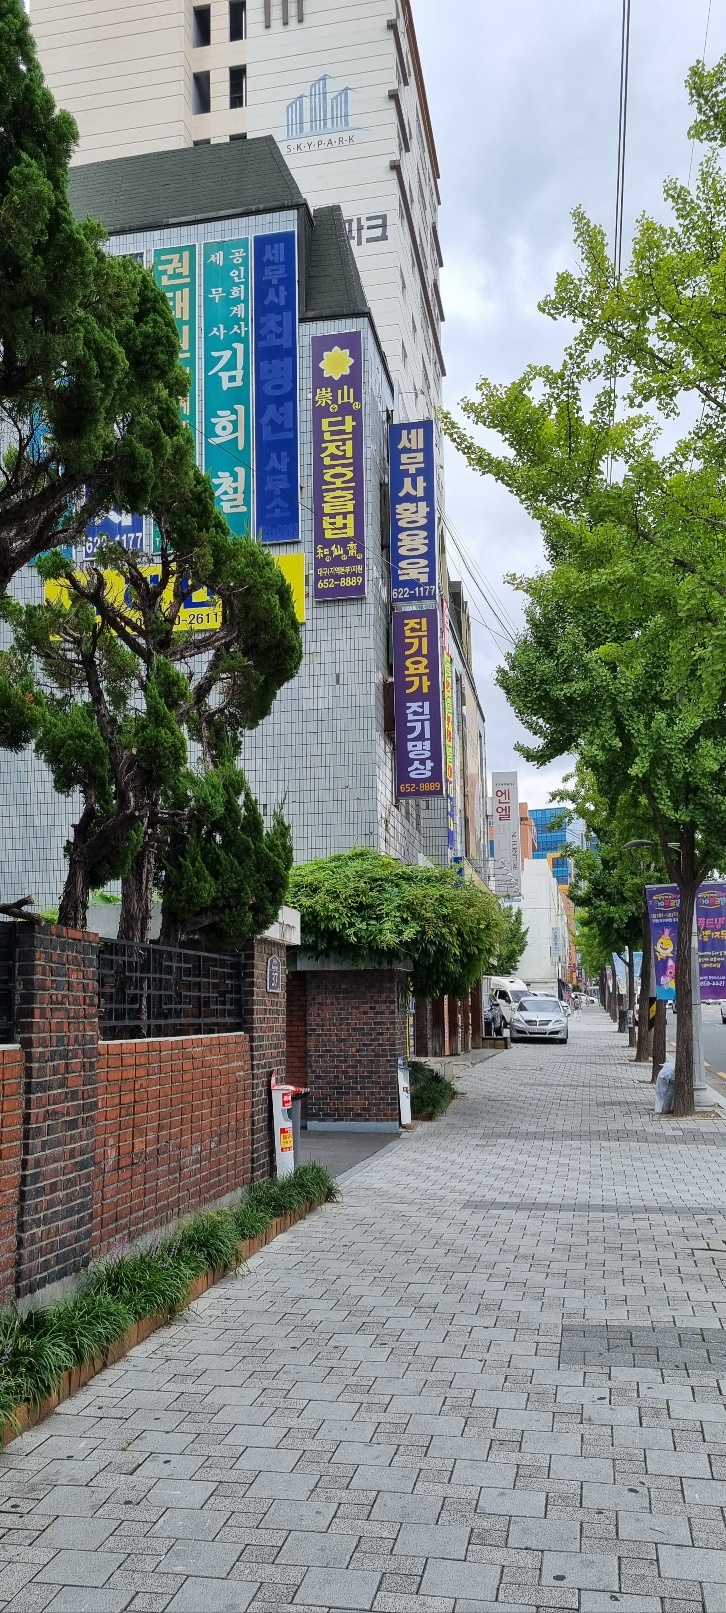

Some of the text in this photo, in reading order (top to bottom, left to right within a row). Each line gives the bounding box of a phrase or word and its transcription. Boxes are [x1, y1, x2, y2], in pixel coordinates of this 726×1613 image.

[228, 248, 248, 338] 공인회계사
[257, 242, 294, 519] 세무사 최병선 사무소
[207, 342, 247, 514] 김희철
[397, 427, 426, 498] 세무사
[319, 414, 357, 540] 단전호흡법
[85, 531, 143, 554] 62177
[394, 501, 430, 583] 황용욱
[317, 576, 363, 589] 652-8889
[392, 585, 436, 599] 622-1177
[403, 617, 431, 695] 진기요가
[405, 700, 435, 780] 진기명상
[399, 781, 441, 794] 652-8889
[495, 788, 512, 822] 엔엘
